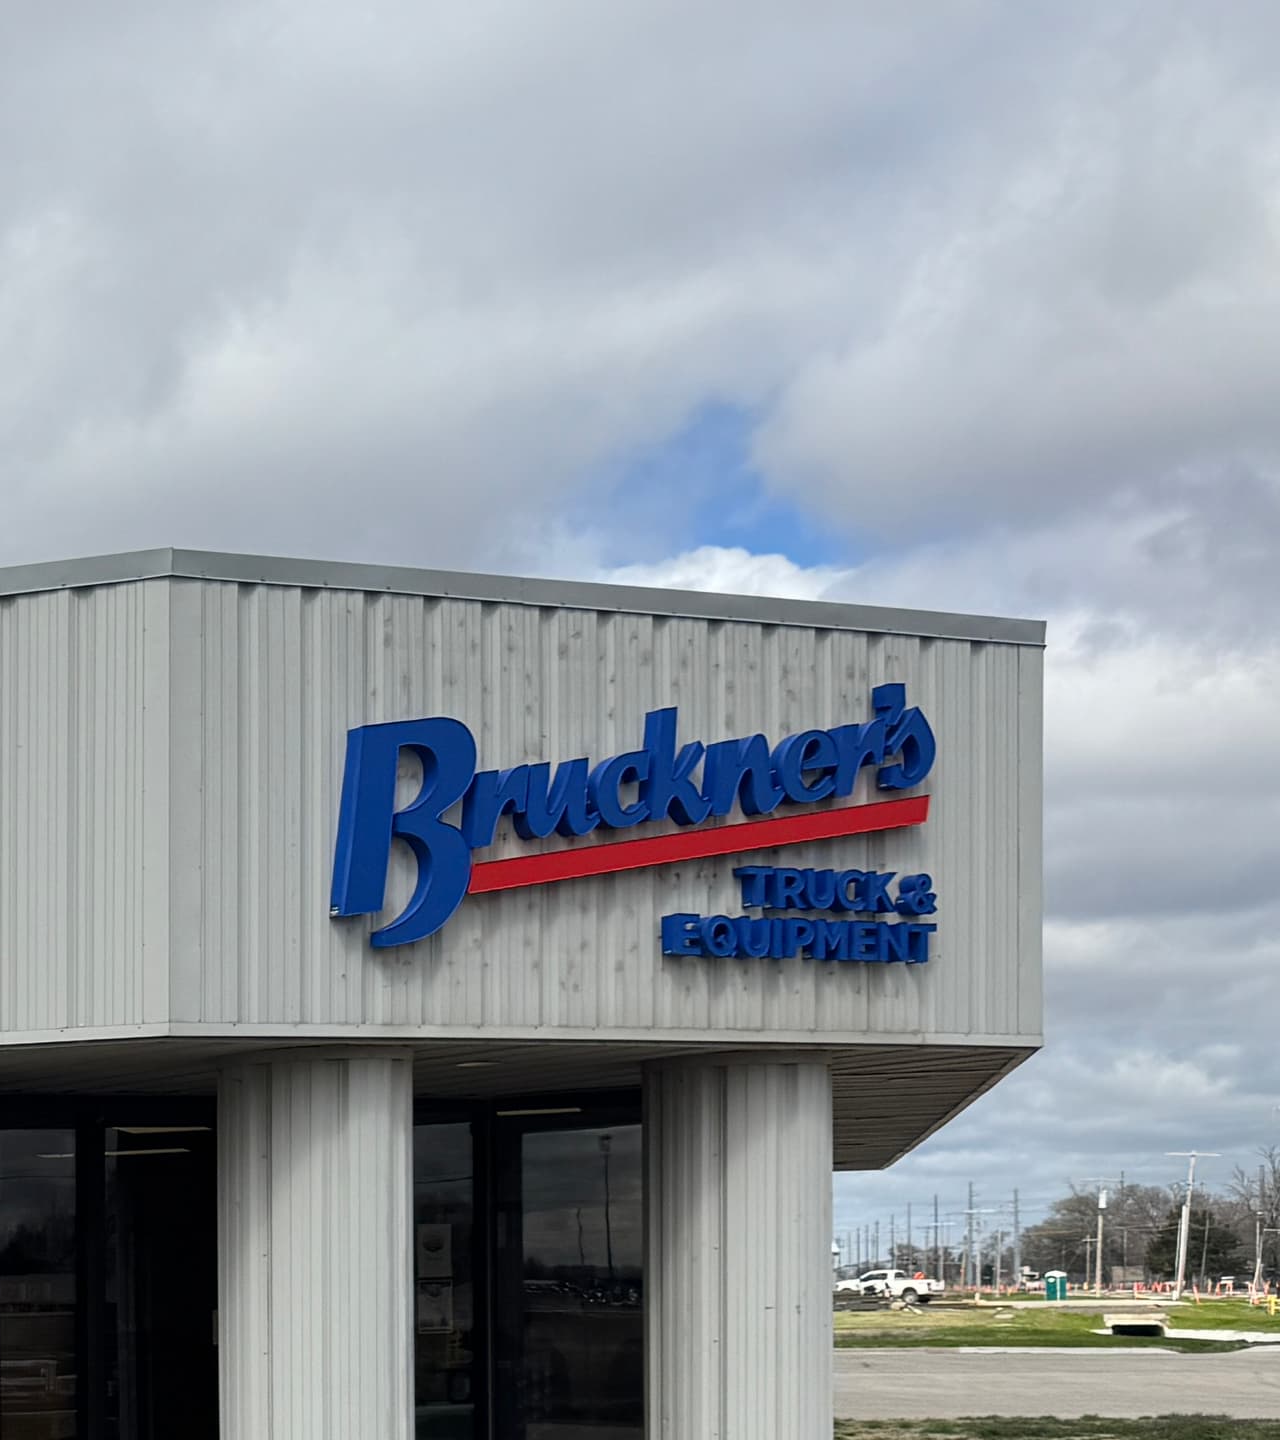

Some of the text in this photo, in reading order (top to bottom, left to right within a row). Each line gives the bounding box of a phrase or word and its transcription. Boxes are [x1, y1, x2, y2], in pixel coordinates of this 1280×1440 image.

[330, 683, 936, 947] Bruckner's
[733, 866, 938, 915] TRUCK &
[661, 913, 937, 963] EQUIPMENT
